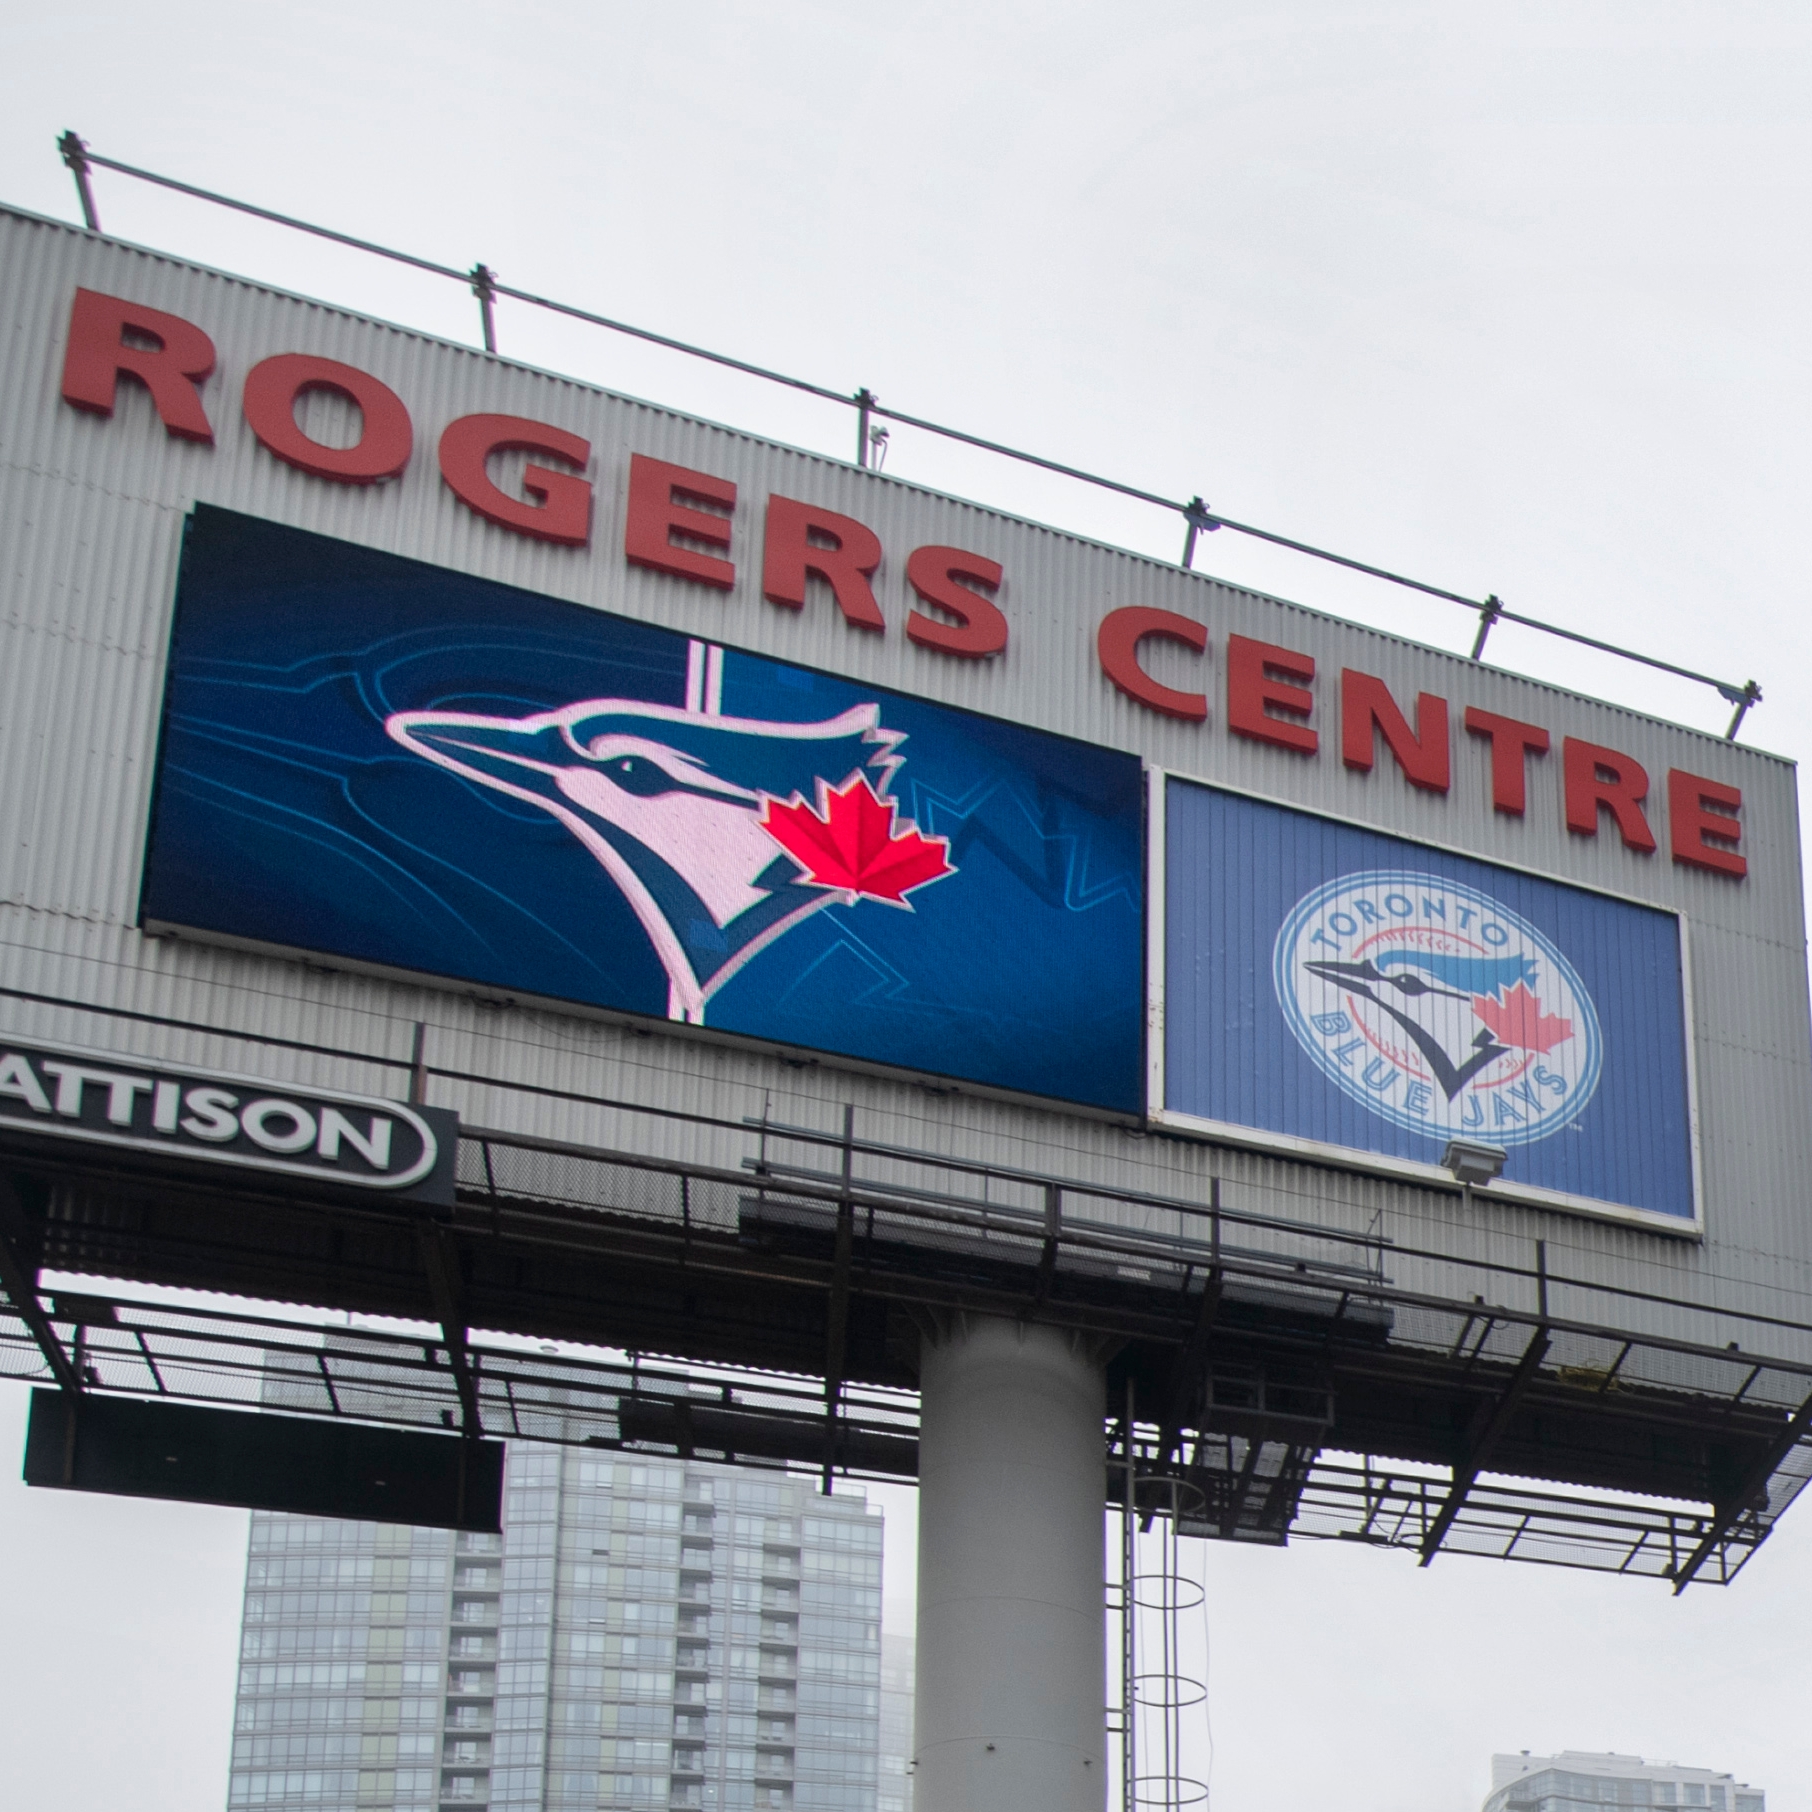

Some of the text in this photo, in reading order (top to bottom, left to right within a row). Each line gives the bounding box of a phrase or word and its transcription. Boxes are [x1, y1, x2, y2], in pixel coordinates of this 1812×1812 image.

[62, 286, 1747, 879] ROGERS CENTRE
[1310, 893, 1508, 953] TORONTO
[1310, 1010, 1567, 1128] BLUE JAYS
